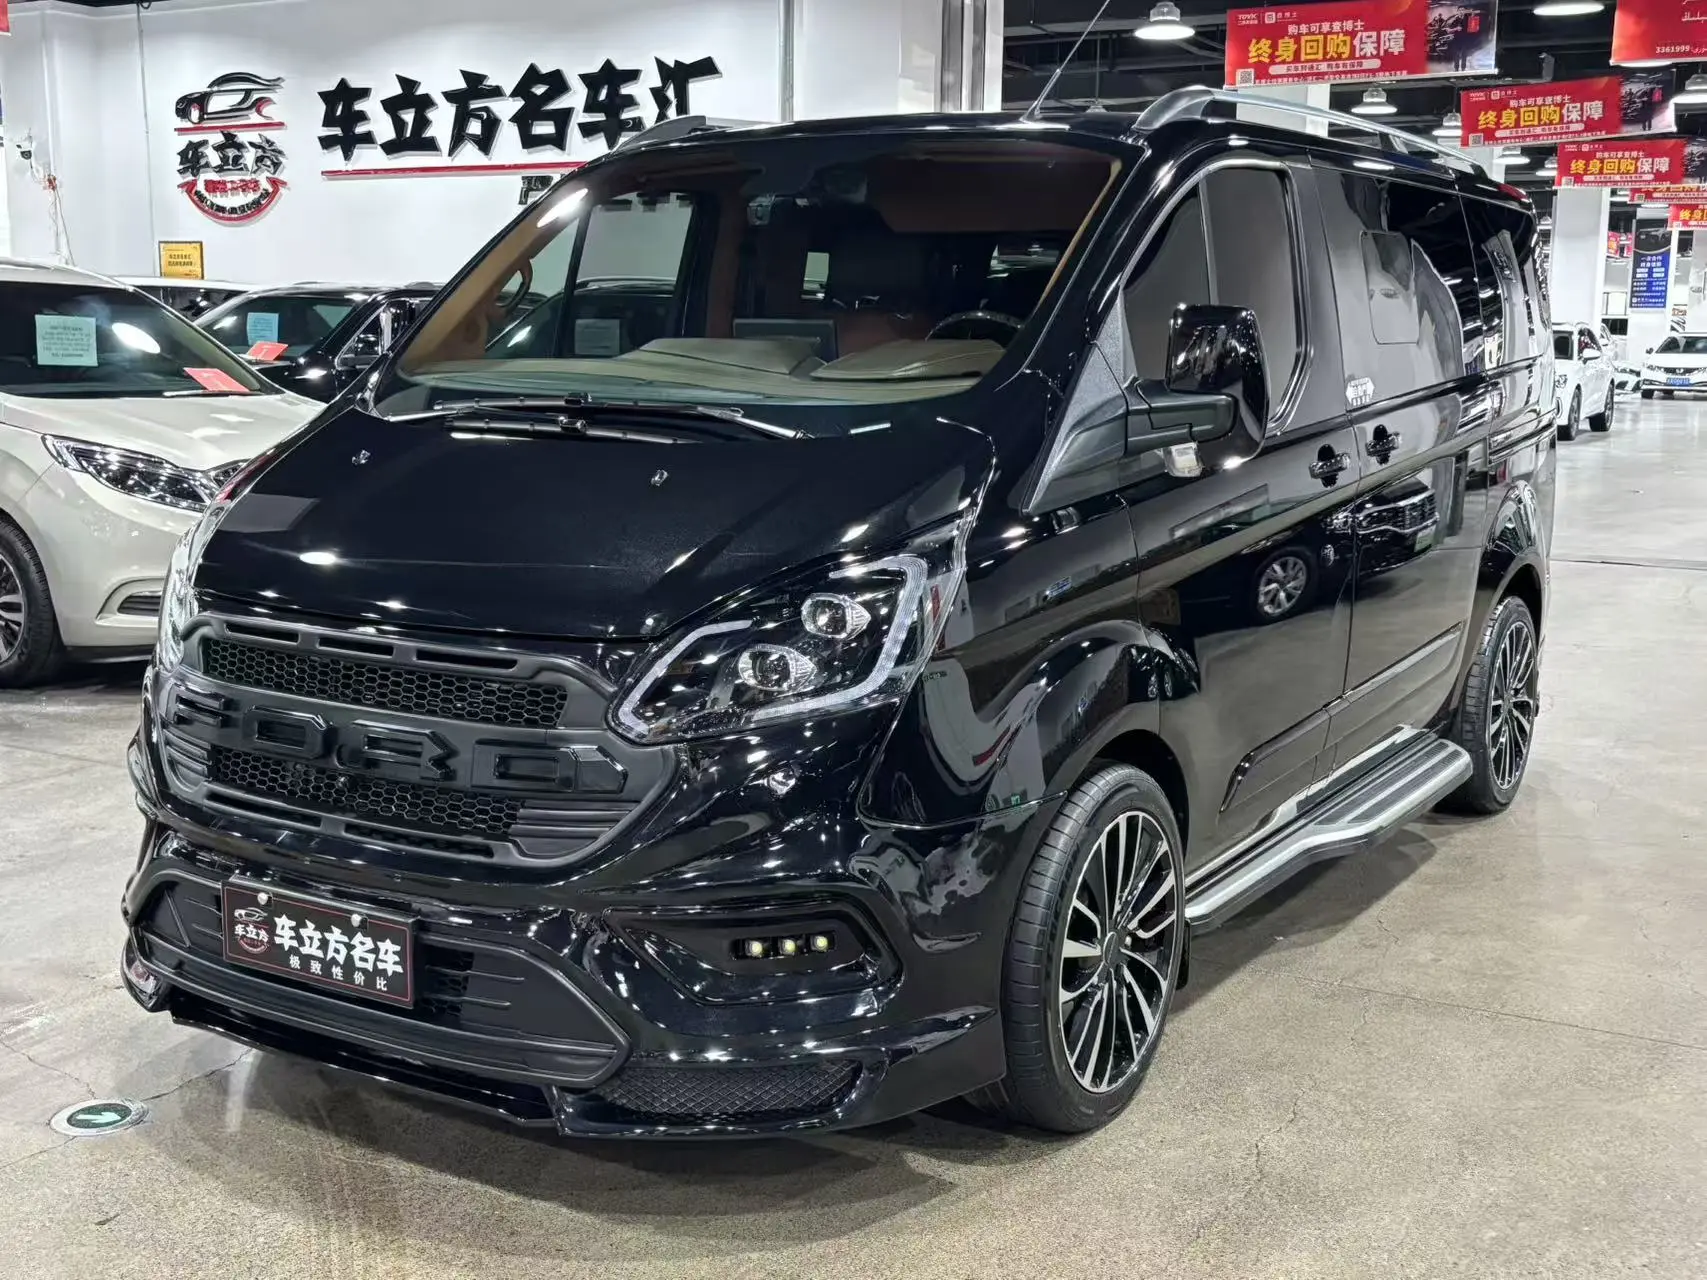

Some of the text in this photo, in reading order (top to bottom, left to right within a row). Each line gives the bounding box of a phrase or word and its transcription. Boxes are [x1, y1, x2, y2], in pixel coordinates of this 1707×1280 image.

[1288, 20, 1365, 35] 购车可享查博士
[1248, 29, 1406, 64] 终身回购保障
[1655, 45, 1690, 54] 3361999
[317, 56, 722, 162] 车立方名车汇
[1477, 101, 1604, 129] 终身回购保障
[177, 130, 288, 177] 车立方
[1570, 157, 1670, 174] 终身回购保障
[234, 923, 270, 943] 车立方
[274, 914, 404, 976] 车立方名车
[289, 954, 388, 992] 极致性价比
